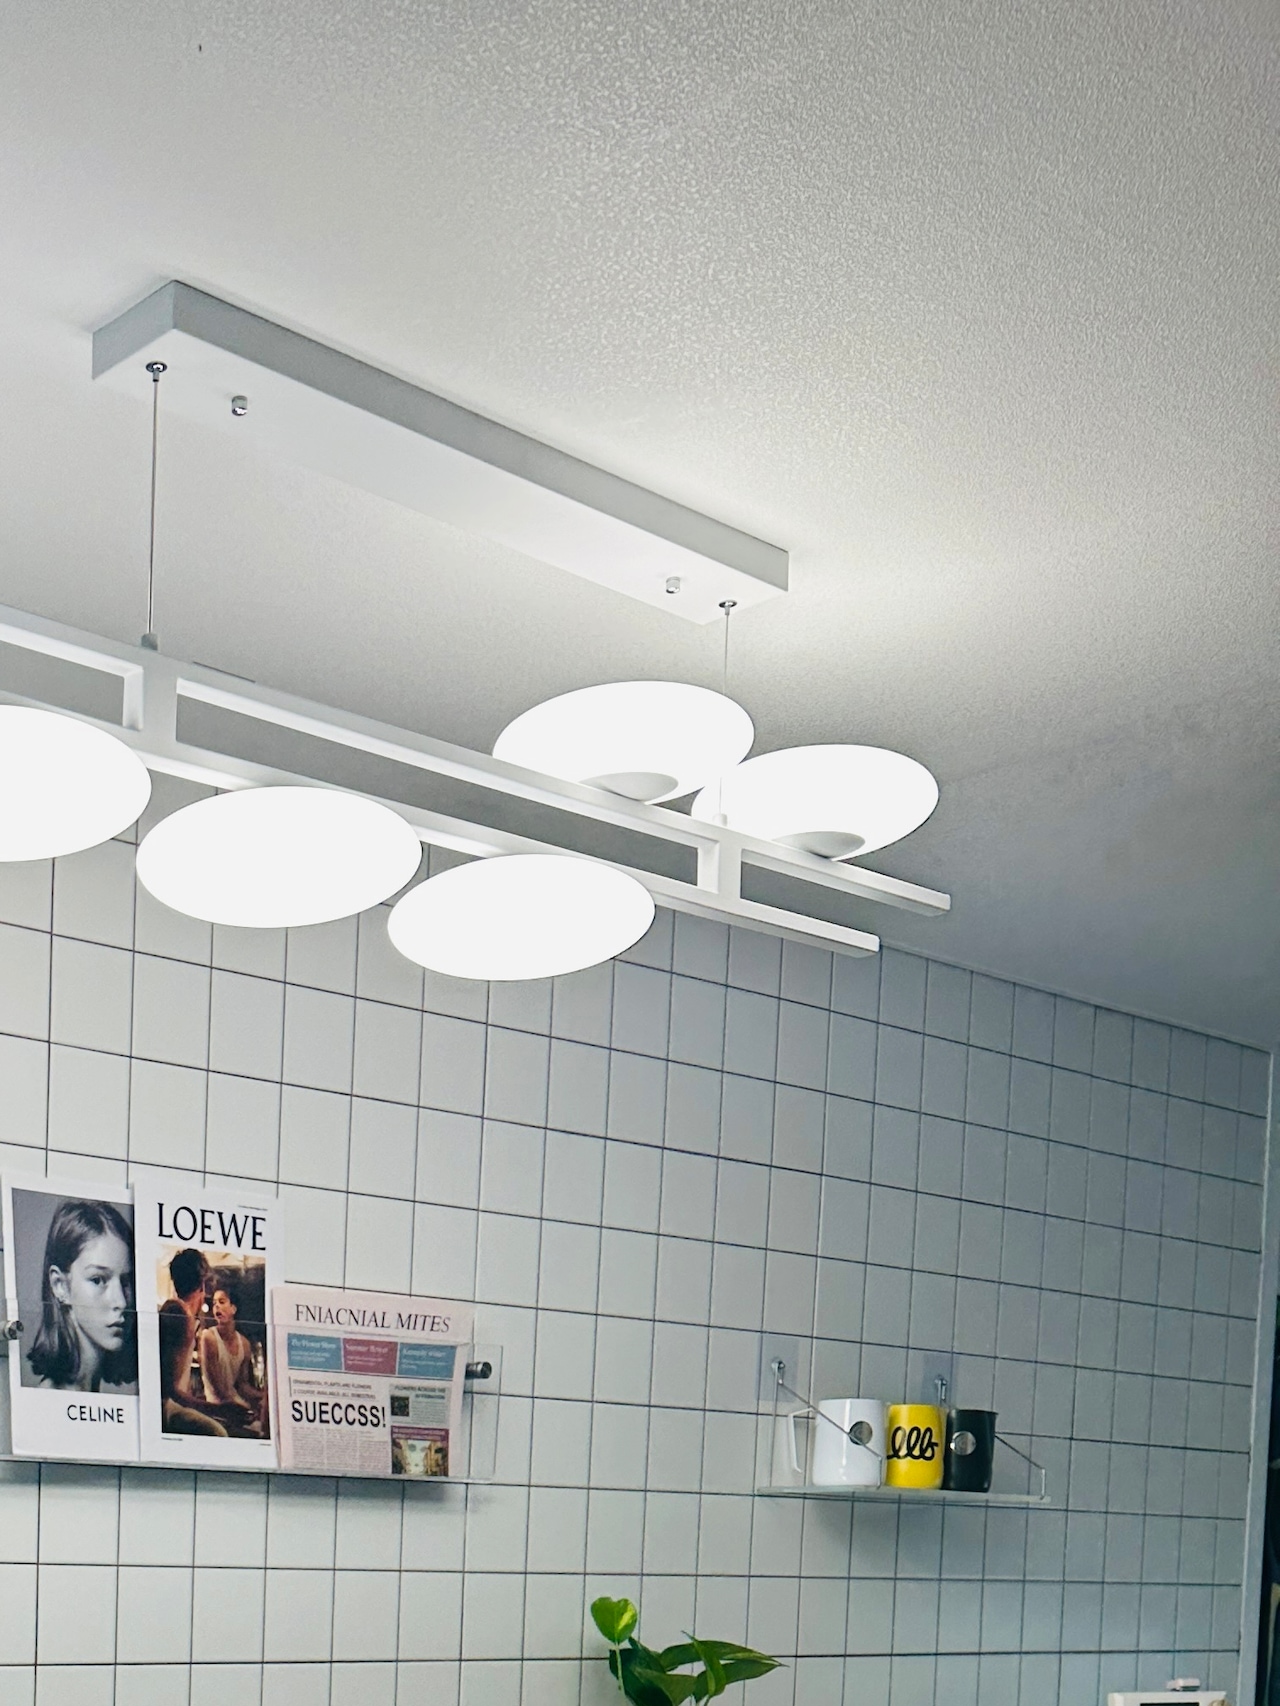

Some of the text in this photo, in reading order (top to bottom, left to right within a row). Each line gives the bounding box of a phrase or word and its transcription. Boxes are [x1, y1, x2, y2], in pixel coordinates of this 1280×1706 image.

[157, 1202, 266, 1251] LOEWE
[295, 1303, 451, 1333] FNIACNIAL MITES
[67, 1404, 124, 1423] CELINE
[291, 1400, 386, 1428] SUECCSS!
